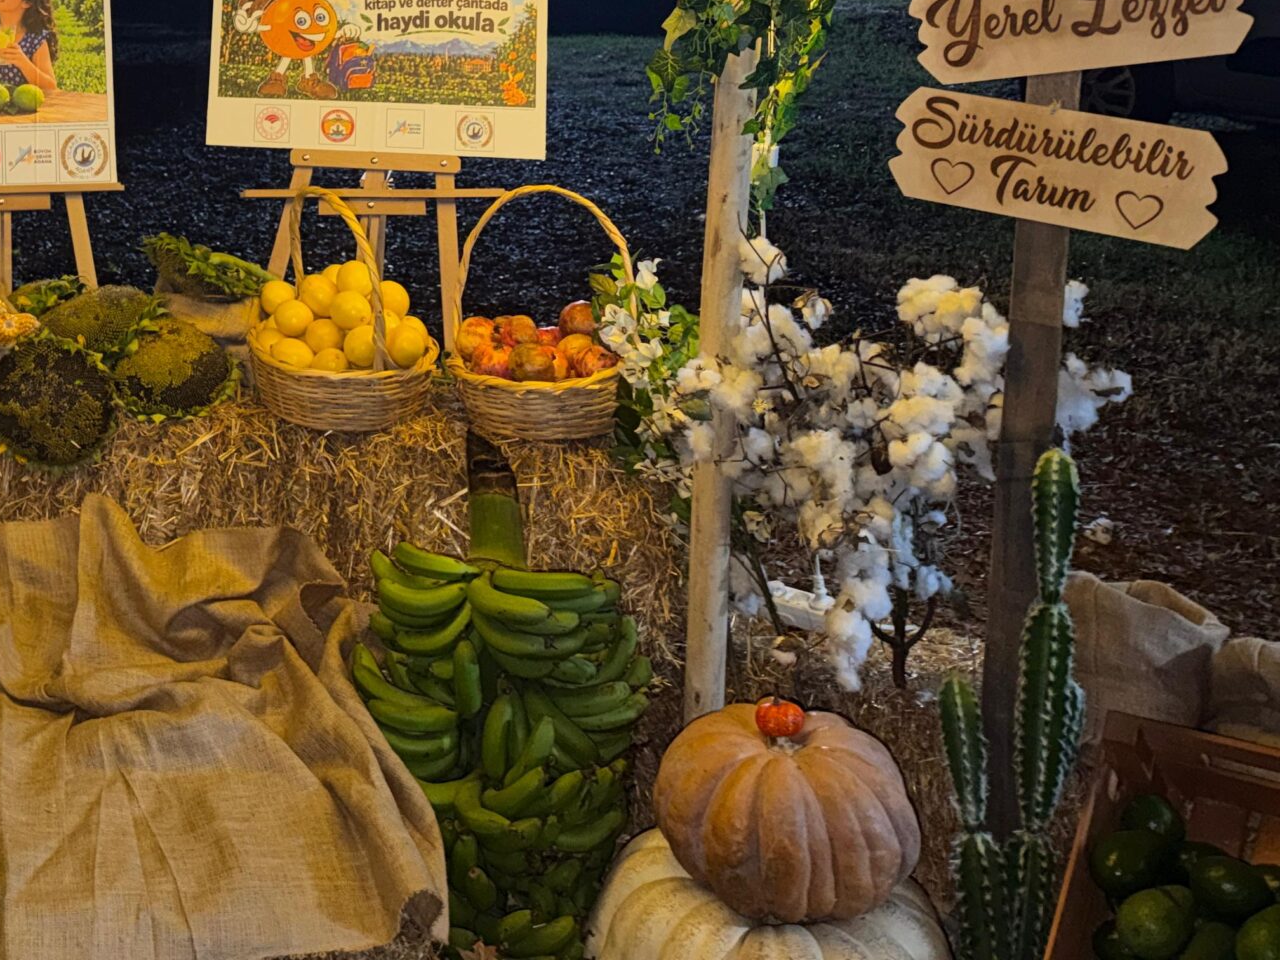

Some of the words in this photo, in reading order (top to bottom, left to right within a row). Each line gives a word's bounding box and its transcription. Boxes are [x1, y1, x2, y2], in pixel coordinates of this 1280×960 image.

[376, 10, 431, 34] haydi
[434, 10, 495, 33] okula
[911, 96, 1195, 181] Sürdürülebilir
[989, 154, 1096, 215] Tarım
